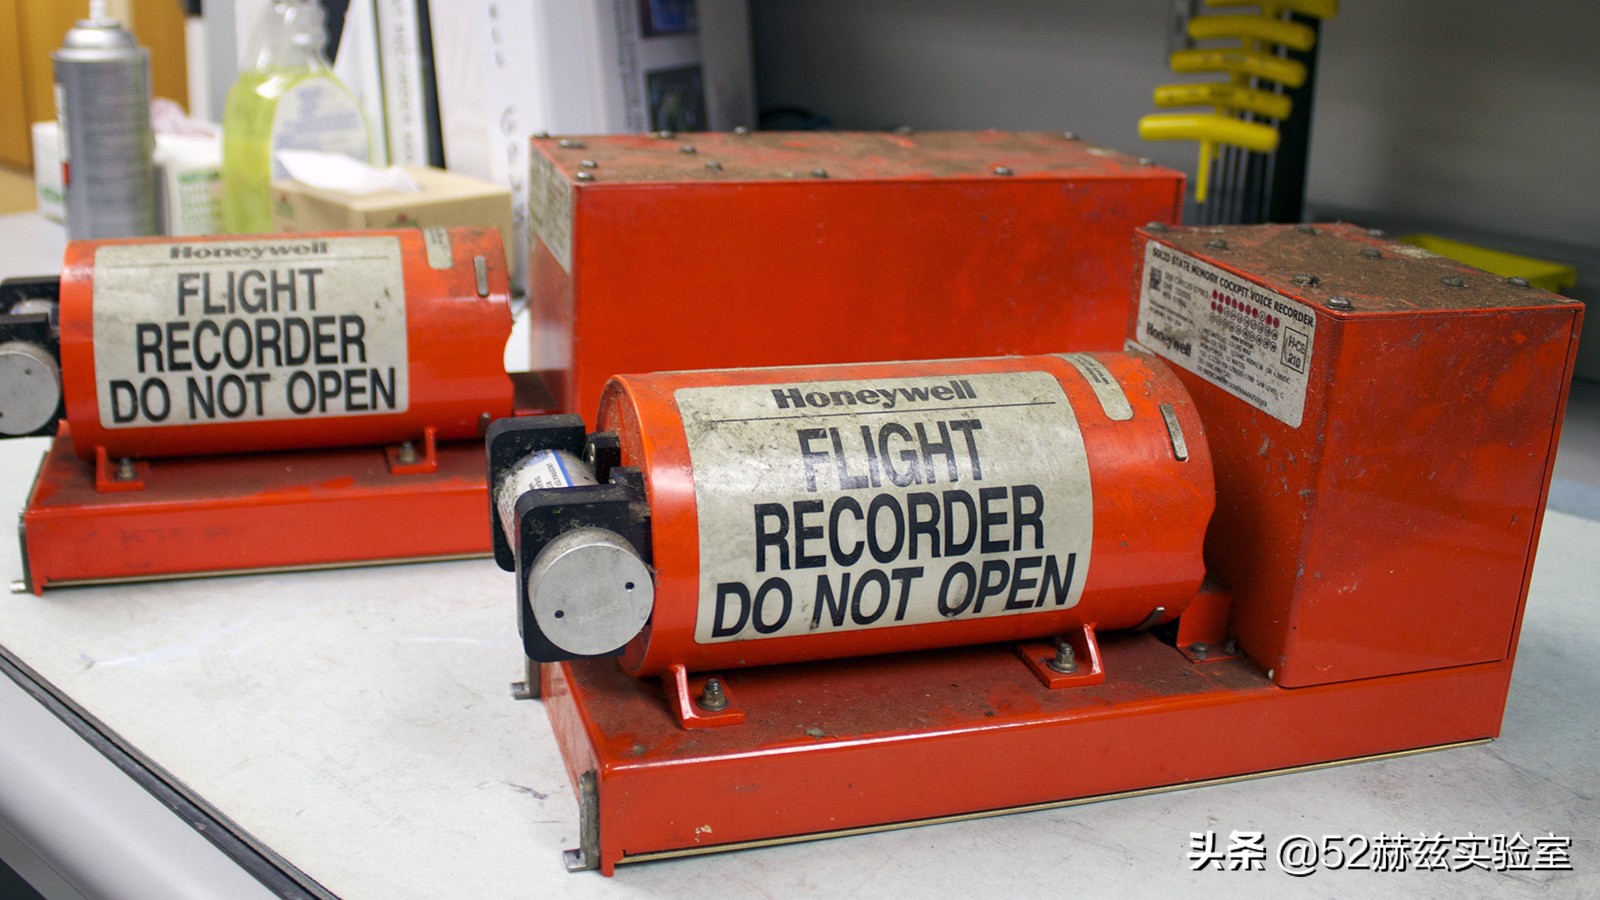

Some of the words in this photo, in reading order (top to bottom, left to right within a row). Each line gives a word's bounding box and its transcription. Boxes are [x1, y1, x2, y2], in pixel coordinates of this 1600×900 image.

[169, 241, 328, 260] Honeywell
[177, 267, 323, 316] FLIGHT
[1171, 255, 1190, 271] STATE
[1191, 264, 1218, 284] MEMORY
[1219, 277, 1249, 297] COCKPIT
[1250, 290, 1272, 308] VOICE
[1273, 300, 1313, 327] RECORDER
[136, 314, 366, 373] RECORDER
[1146, 321, 1191, 359] Honeywell
[1287, 351, 1300, 369] 210
[109, 376, 171, 423] DO
[187, 373, 270, 420] NOT
[286, 366, 396, 415] OPEN
[770, 379, 978, 409] Honeywell
[797, 418, 983, 492] FLIGHT
[753, 484, 1045, 572] RECORDER
[711, 576, 793, 638] DO
[811, 566, 925, 630] NOT
[937, 552, 1077, 618] OPEN
